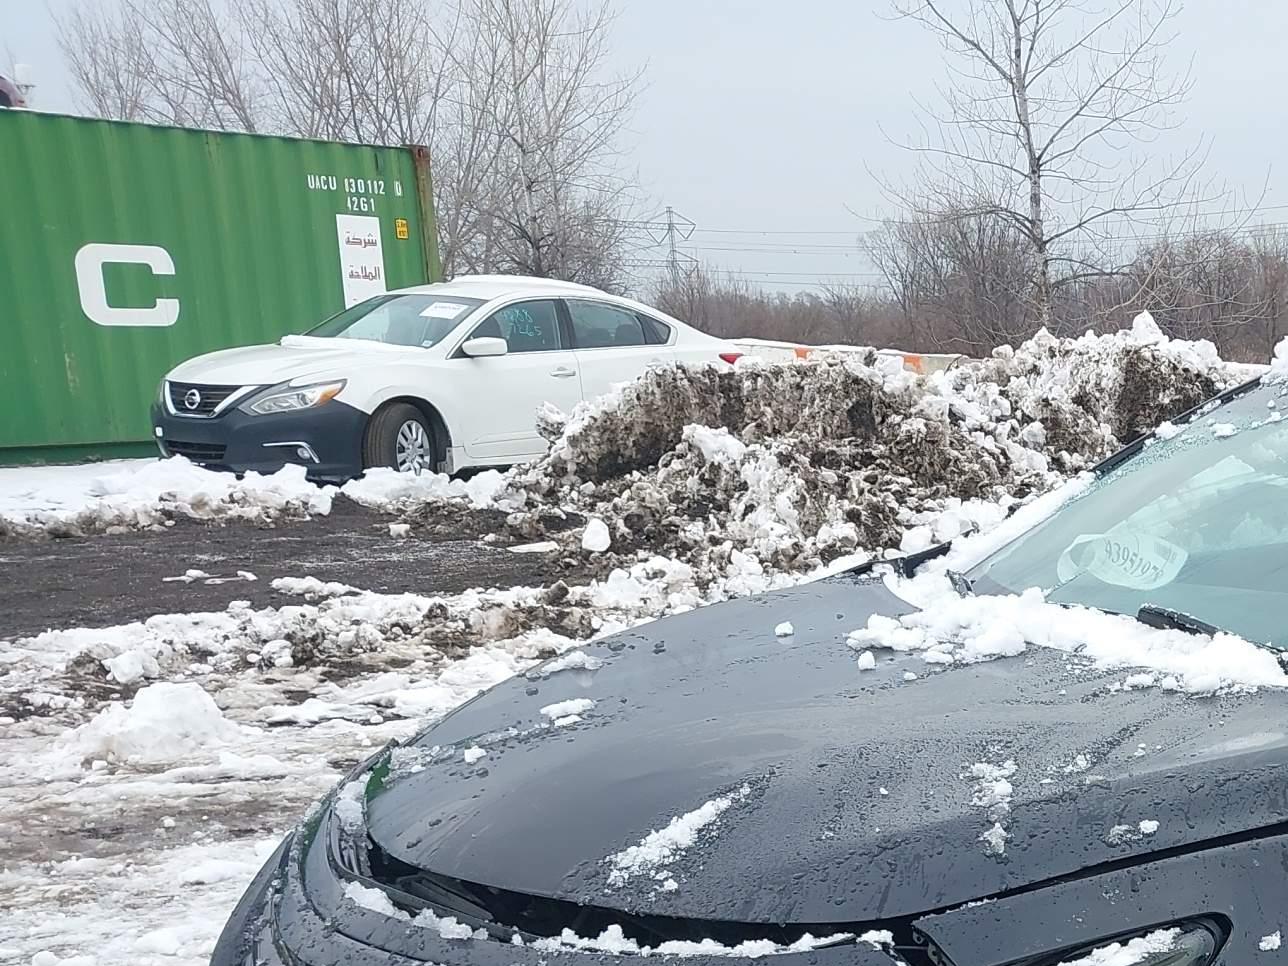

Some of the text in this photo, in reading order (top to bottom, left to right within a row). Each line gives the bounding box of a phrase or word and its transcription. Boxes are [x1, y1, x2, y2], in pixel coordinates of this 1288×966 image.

[307, 174, 337, 190] UACU
[347, 196, 375, 212] 42G1
[345, 231, 377, 248] شركة
[349, 264, 380, 281] الملاحة
[75, 243, 179, 326] C
